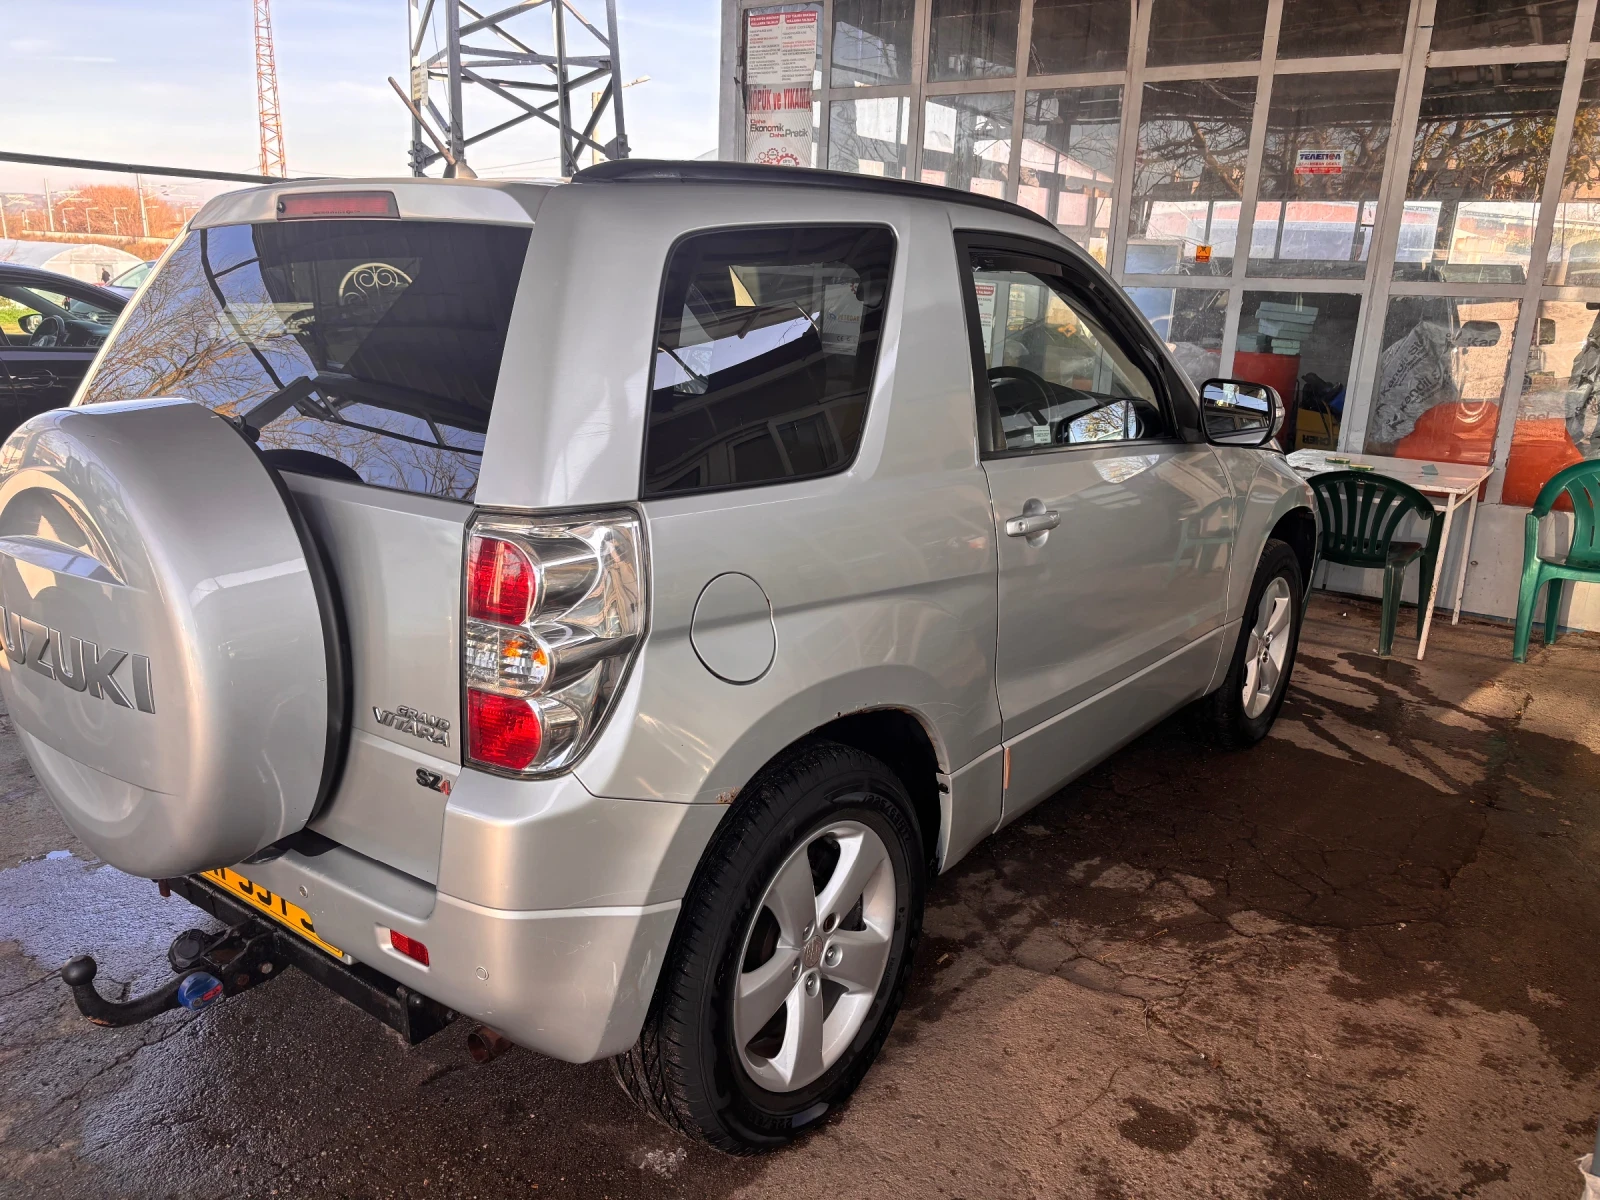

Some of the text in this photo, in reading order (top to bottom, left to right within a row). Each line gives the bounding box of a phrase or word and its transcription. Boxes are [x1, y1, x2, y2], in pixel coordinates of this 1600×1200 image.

[748, 85, 772, 111] KÖPÜK
[772, 92, 782, 110] ve
[750, 123, 784, 132] Ekonomik
[785, 128, 808, 137] Pratik
[0, 605, 156, 715] UZUKI
[372, 705, 450, 748] VITARA
[396, 704, 450, 731] GRAND
[415, 766, 451, 796] SZ4
